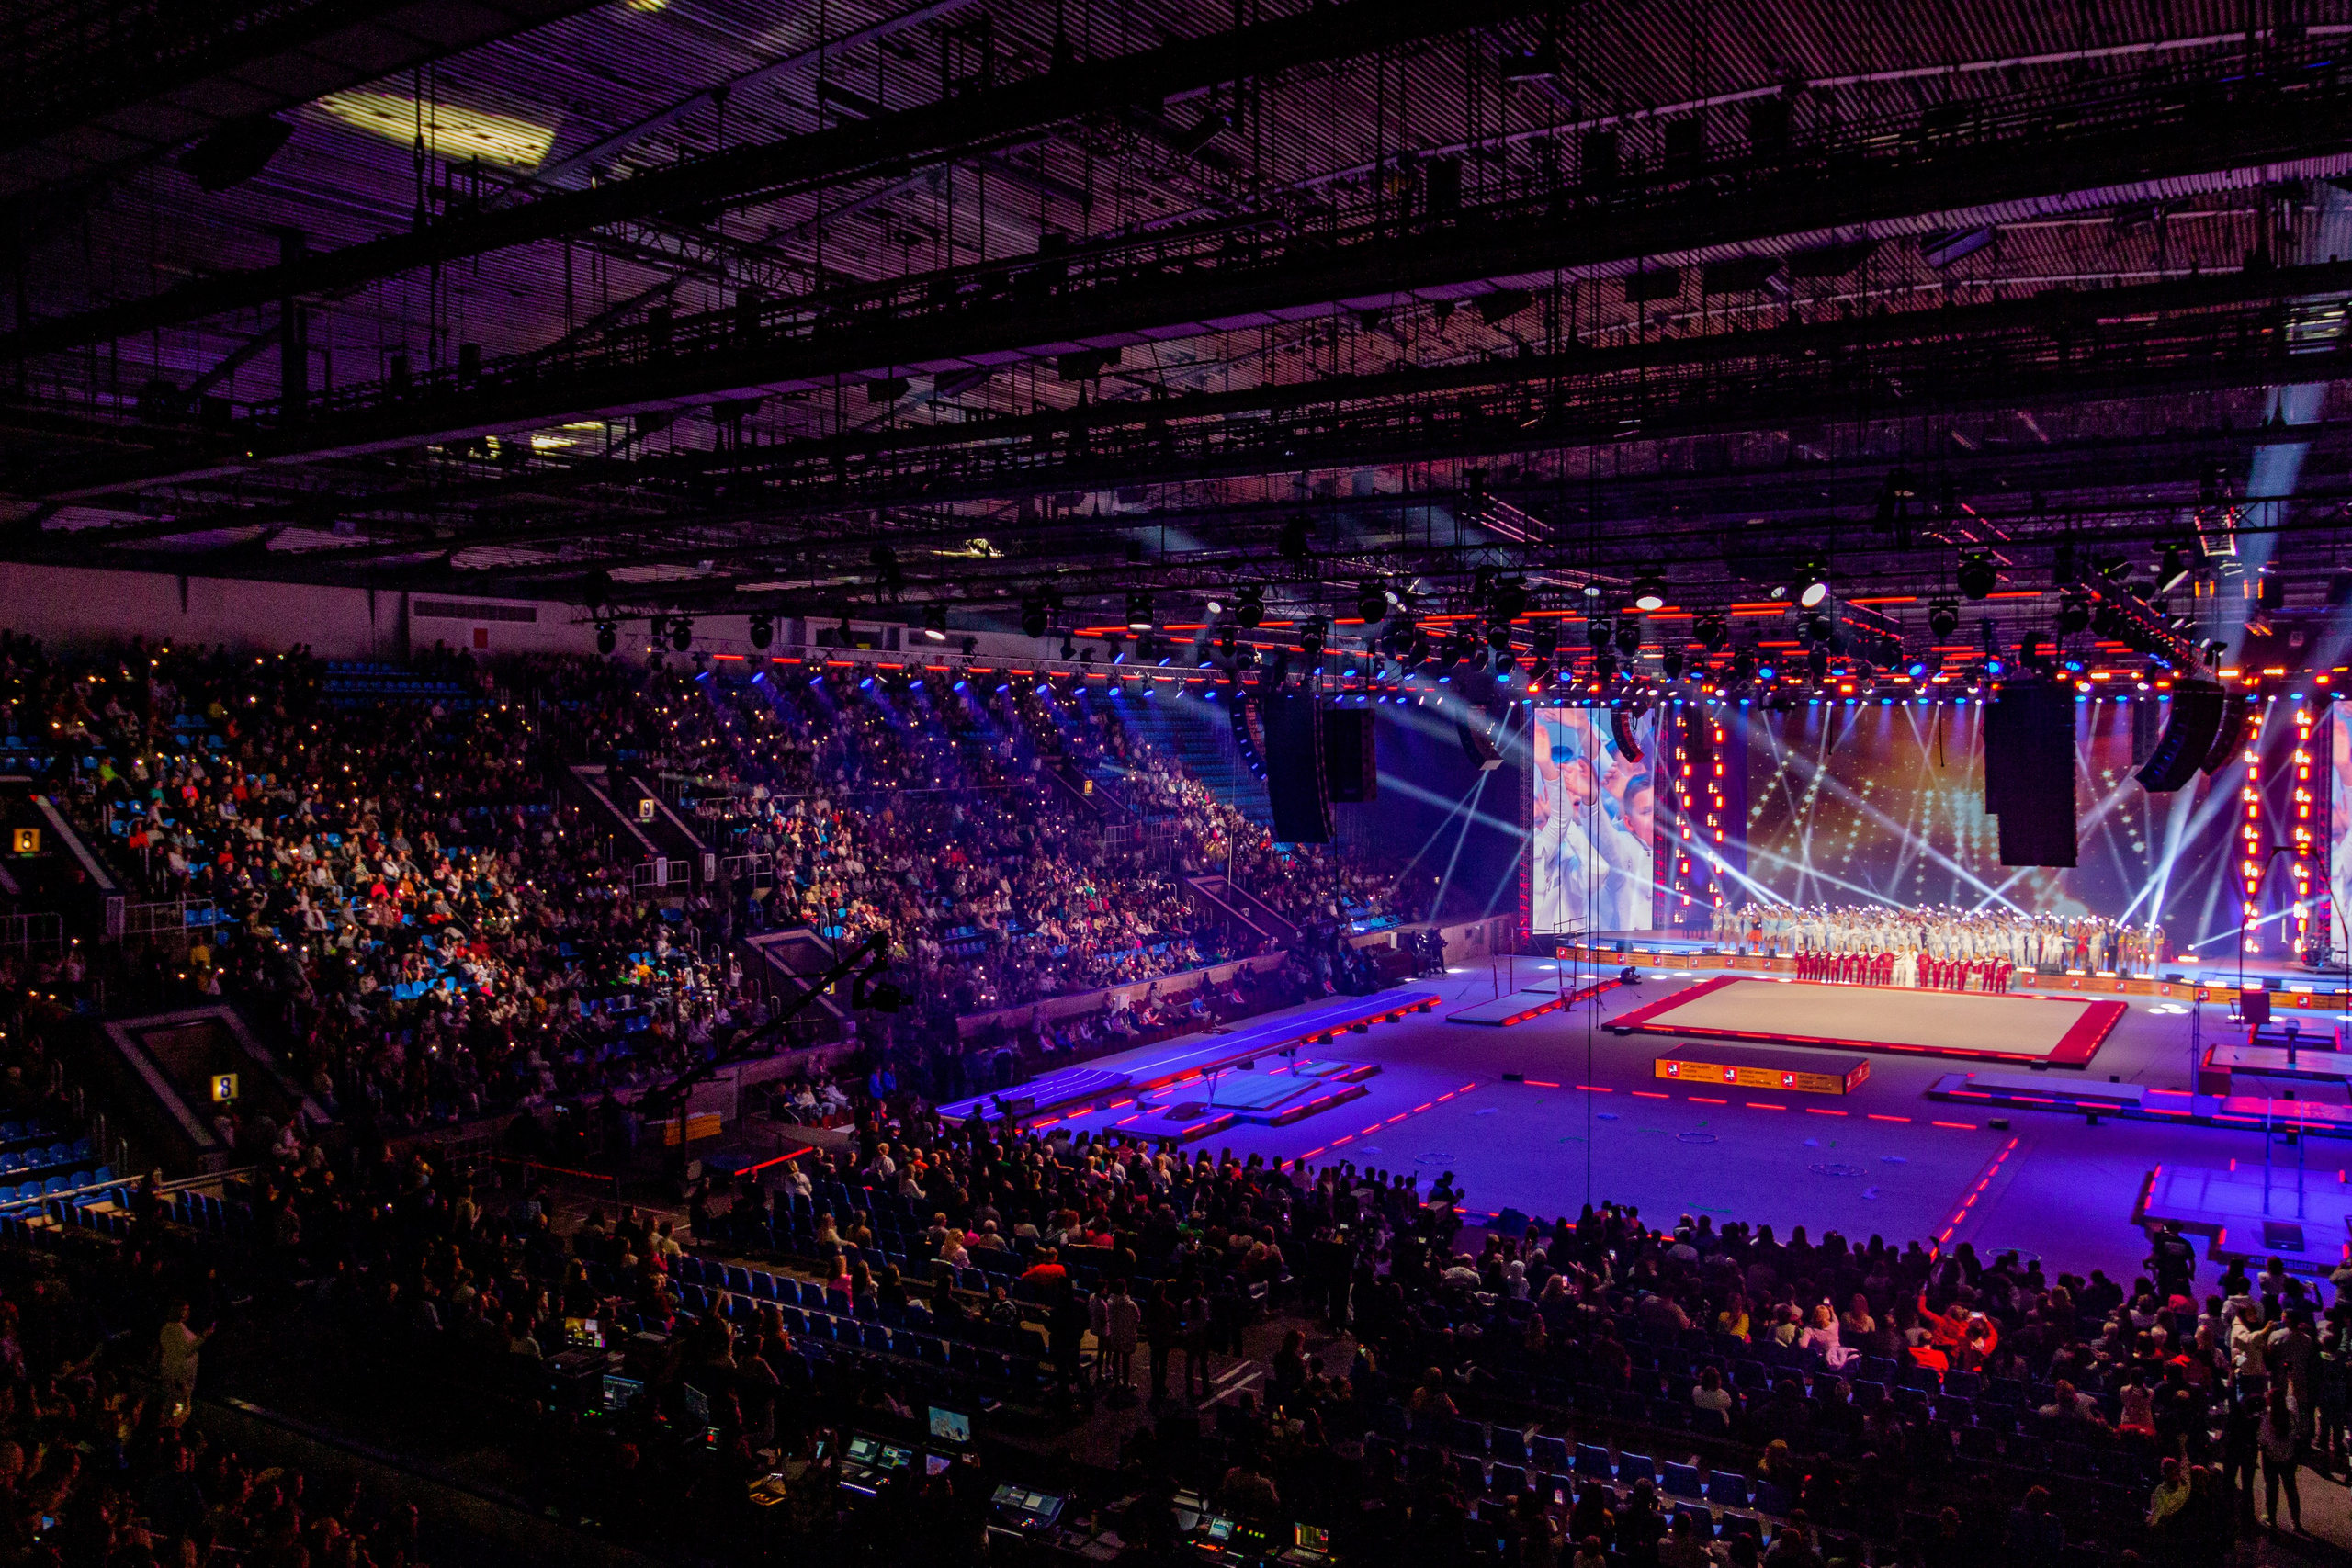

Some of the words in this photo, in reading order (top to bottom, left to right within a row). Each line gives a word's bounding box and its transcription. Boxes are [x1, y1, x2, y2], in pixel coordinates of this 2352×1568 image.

[1086, 781, 1091, 792] 10
[644, 801, 650, 816] 9
[22, 831, 32, 849] 8
[220, 1077, 231, 1098] 8
